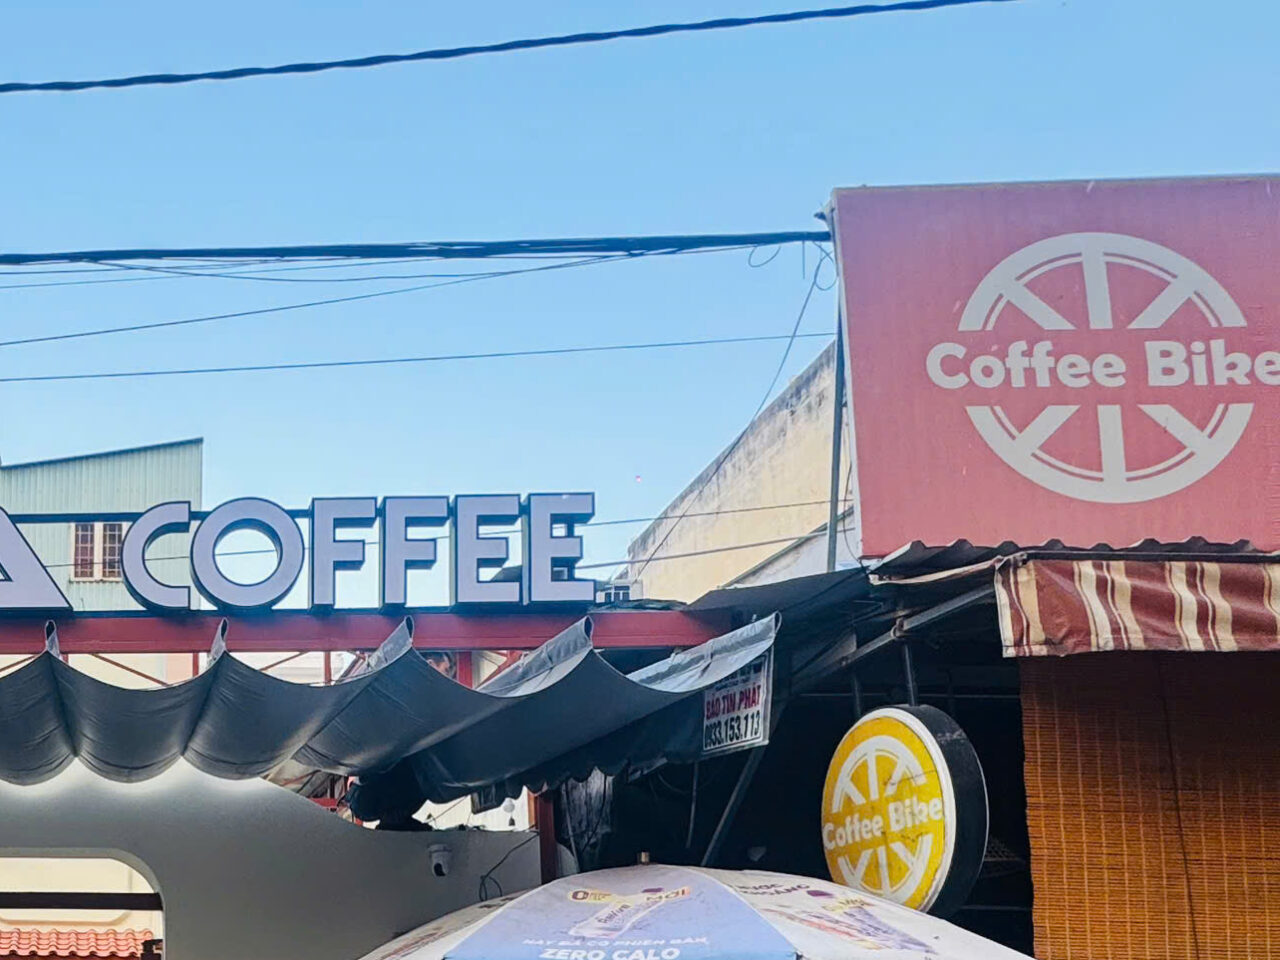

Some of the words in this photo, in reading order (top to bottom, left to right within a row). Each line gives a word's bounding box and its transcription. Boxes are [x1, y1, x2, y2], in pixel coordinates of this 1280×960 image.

[926, 340, 1127, 389] Coffee
[1144, 339, 1280, 386] Bike
[120, 492, 596, 612] COFFEE
[822, 813, 884, 850] Coffee
[888, 794, 942, 833] Bike
